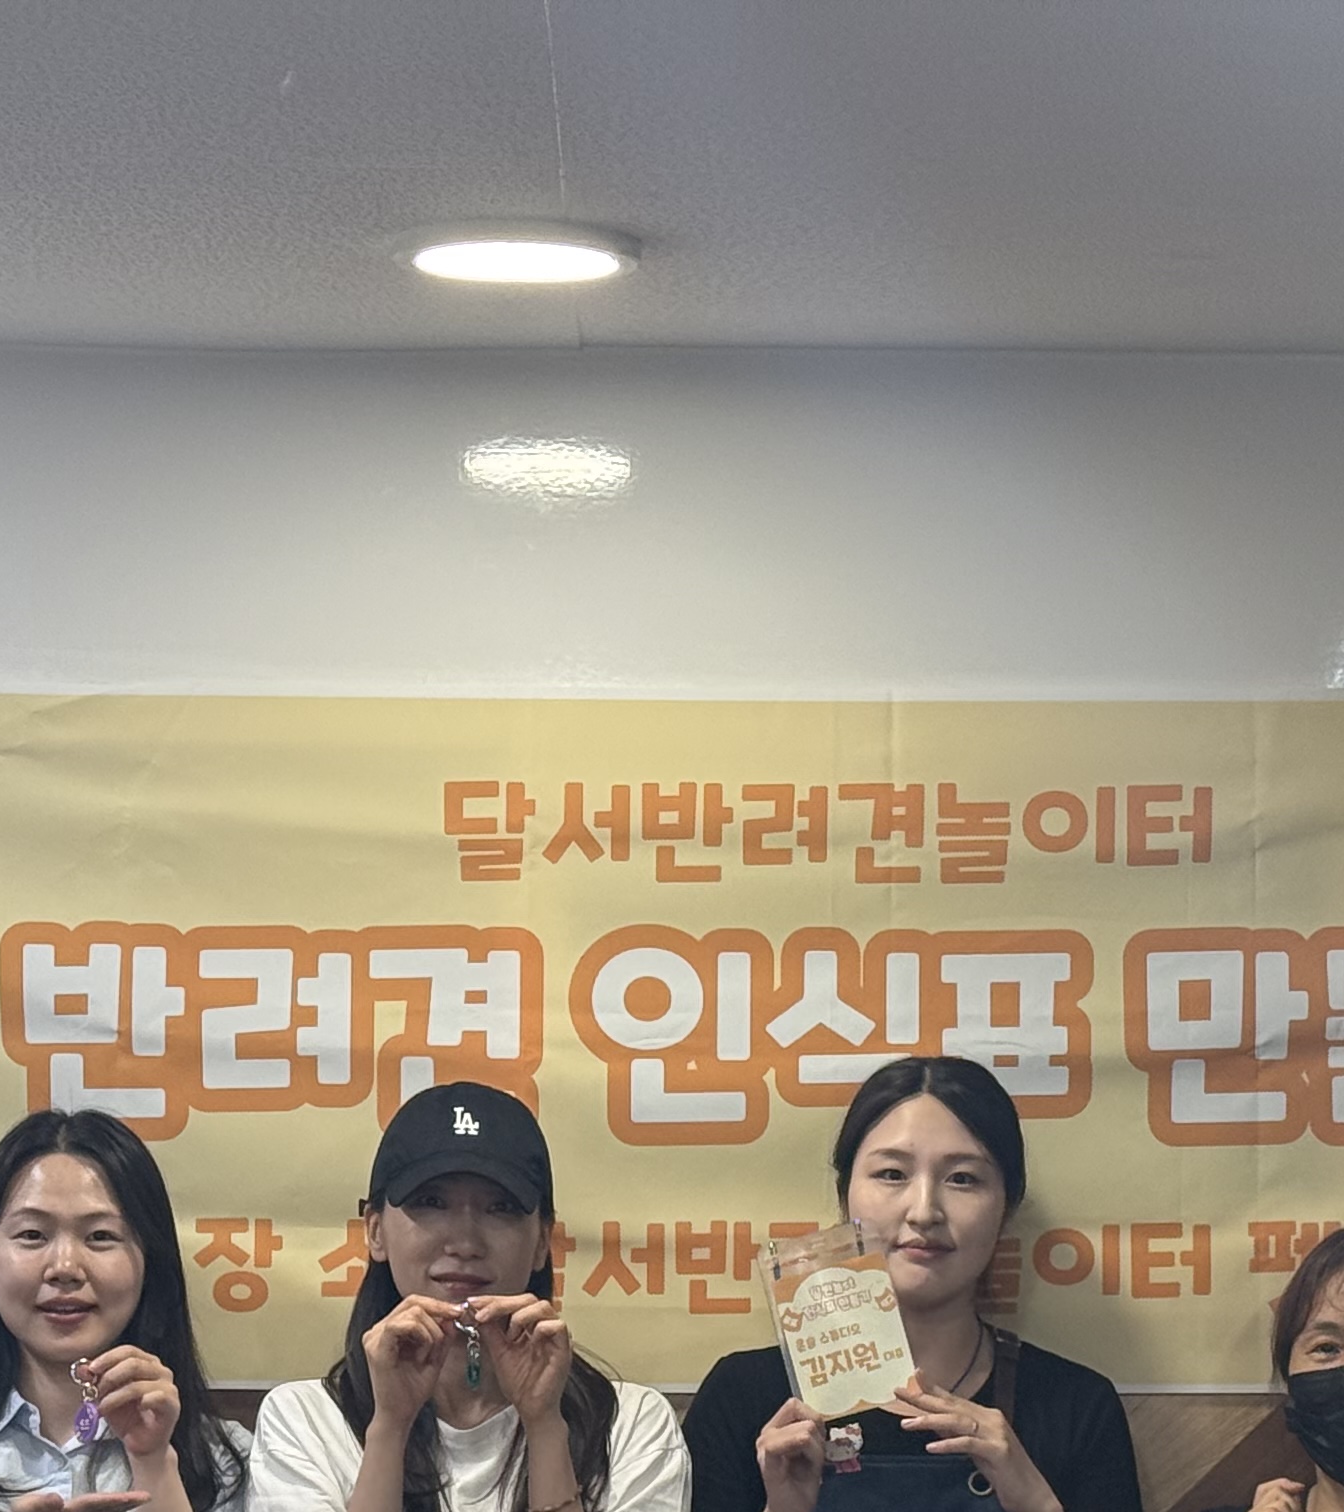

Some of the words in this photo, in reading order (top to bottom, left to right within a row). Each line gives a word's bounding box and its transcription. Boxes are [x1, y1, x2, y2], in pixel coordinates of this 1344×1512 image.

[443, 780, 1214, 885] 달서반려견놀이터
[20, 942, 524, 1119] 반려견
[589, 946, 1073, 1124] 인식표
[452, 1106, 480, 1136] LA
[193, 1217, 284, 1313] 장
[798, 1340, 882, 1389] 김지원
